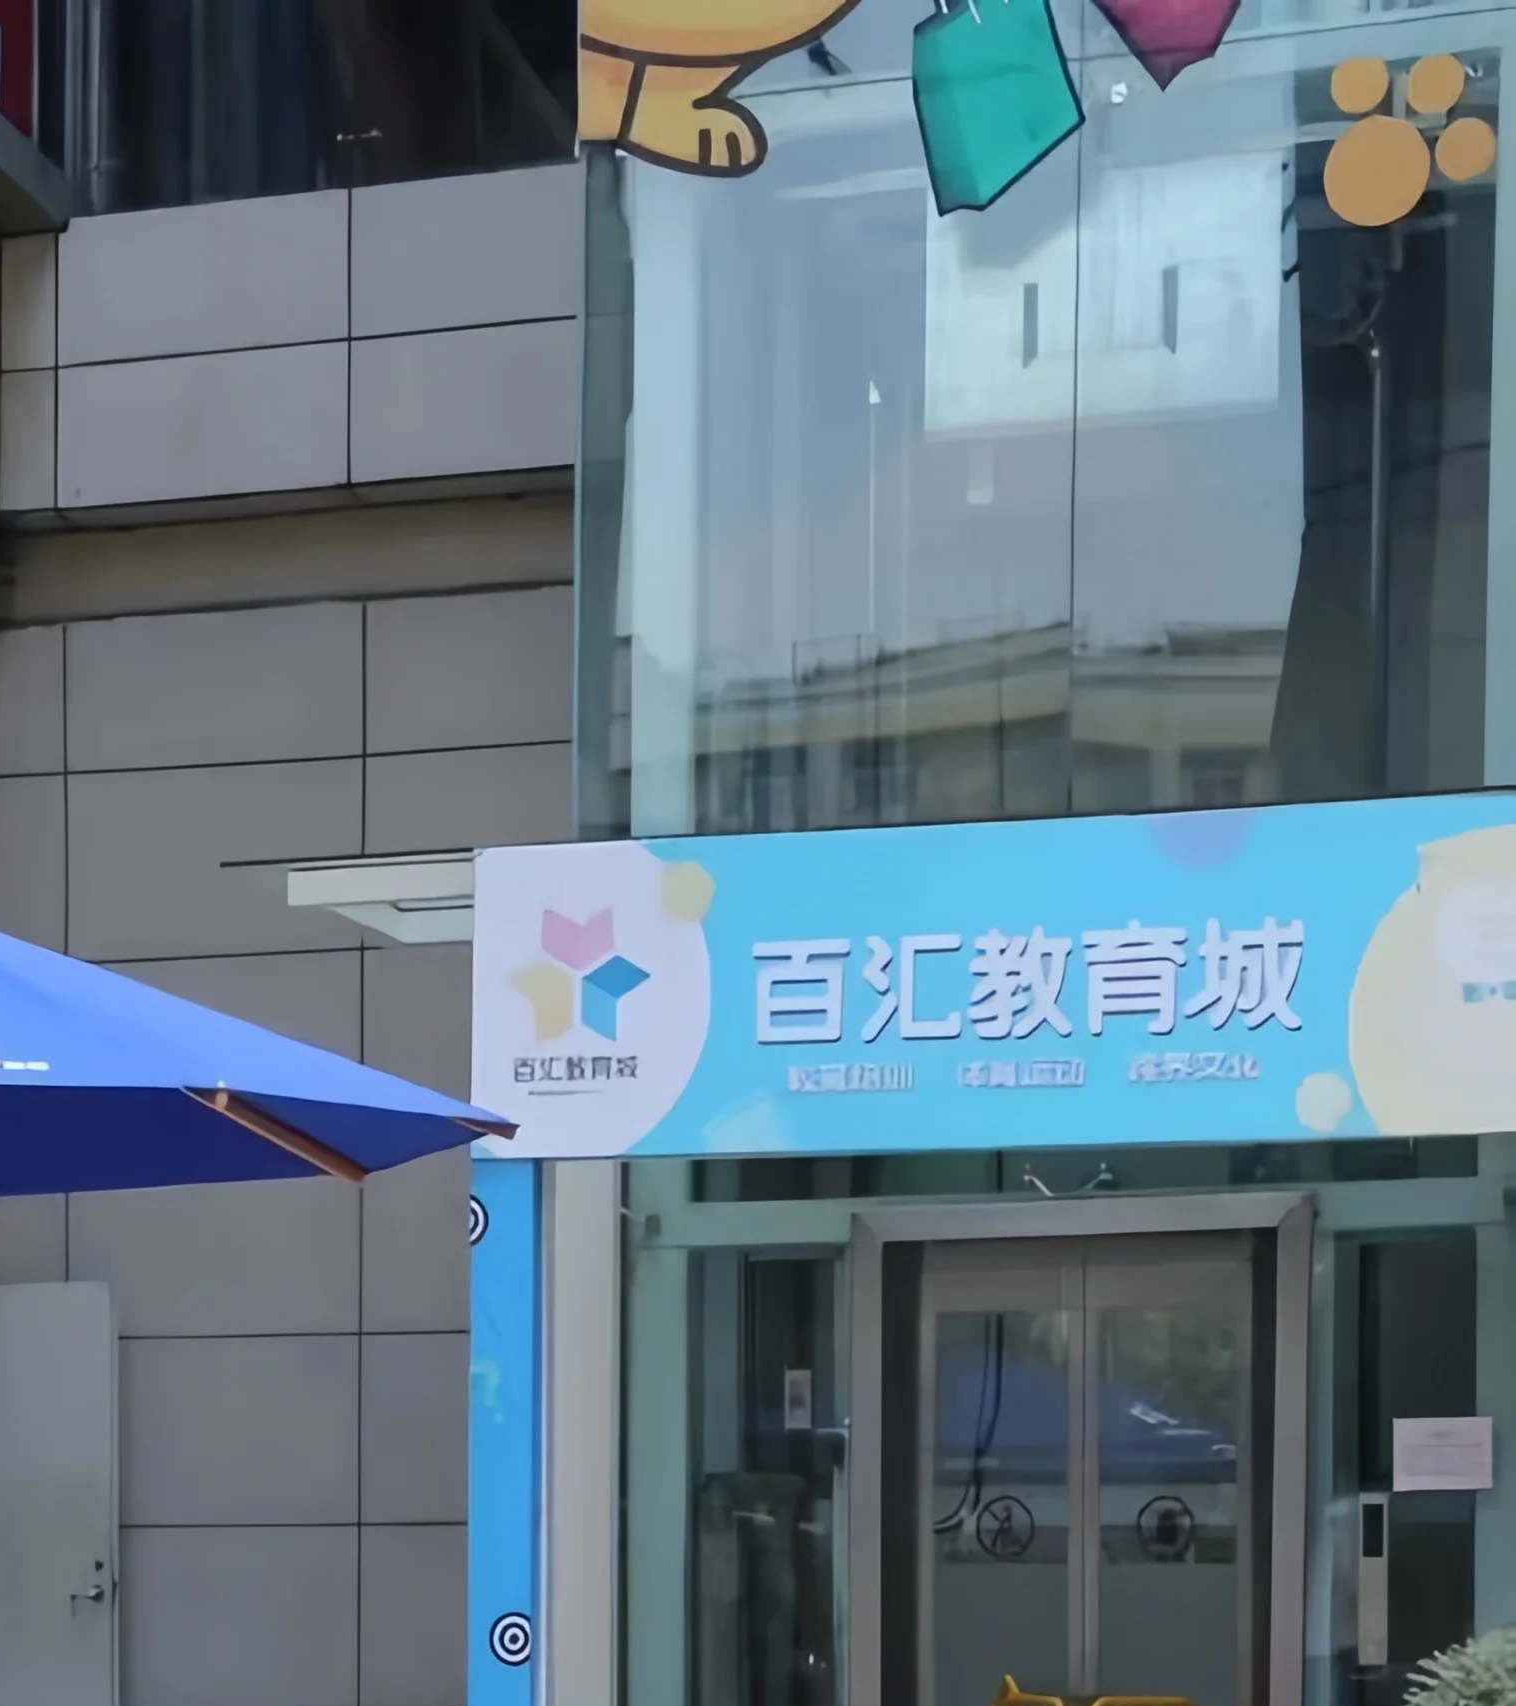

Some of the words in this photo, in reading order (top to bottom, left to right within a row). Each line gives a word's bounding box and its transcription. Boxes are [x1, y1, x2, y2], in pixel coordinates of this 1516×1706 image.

[751, 914, 1306, 1046] 百汇教育城
